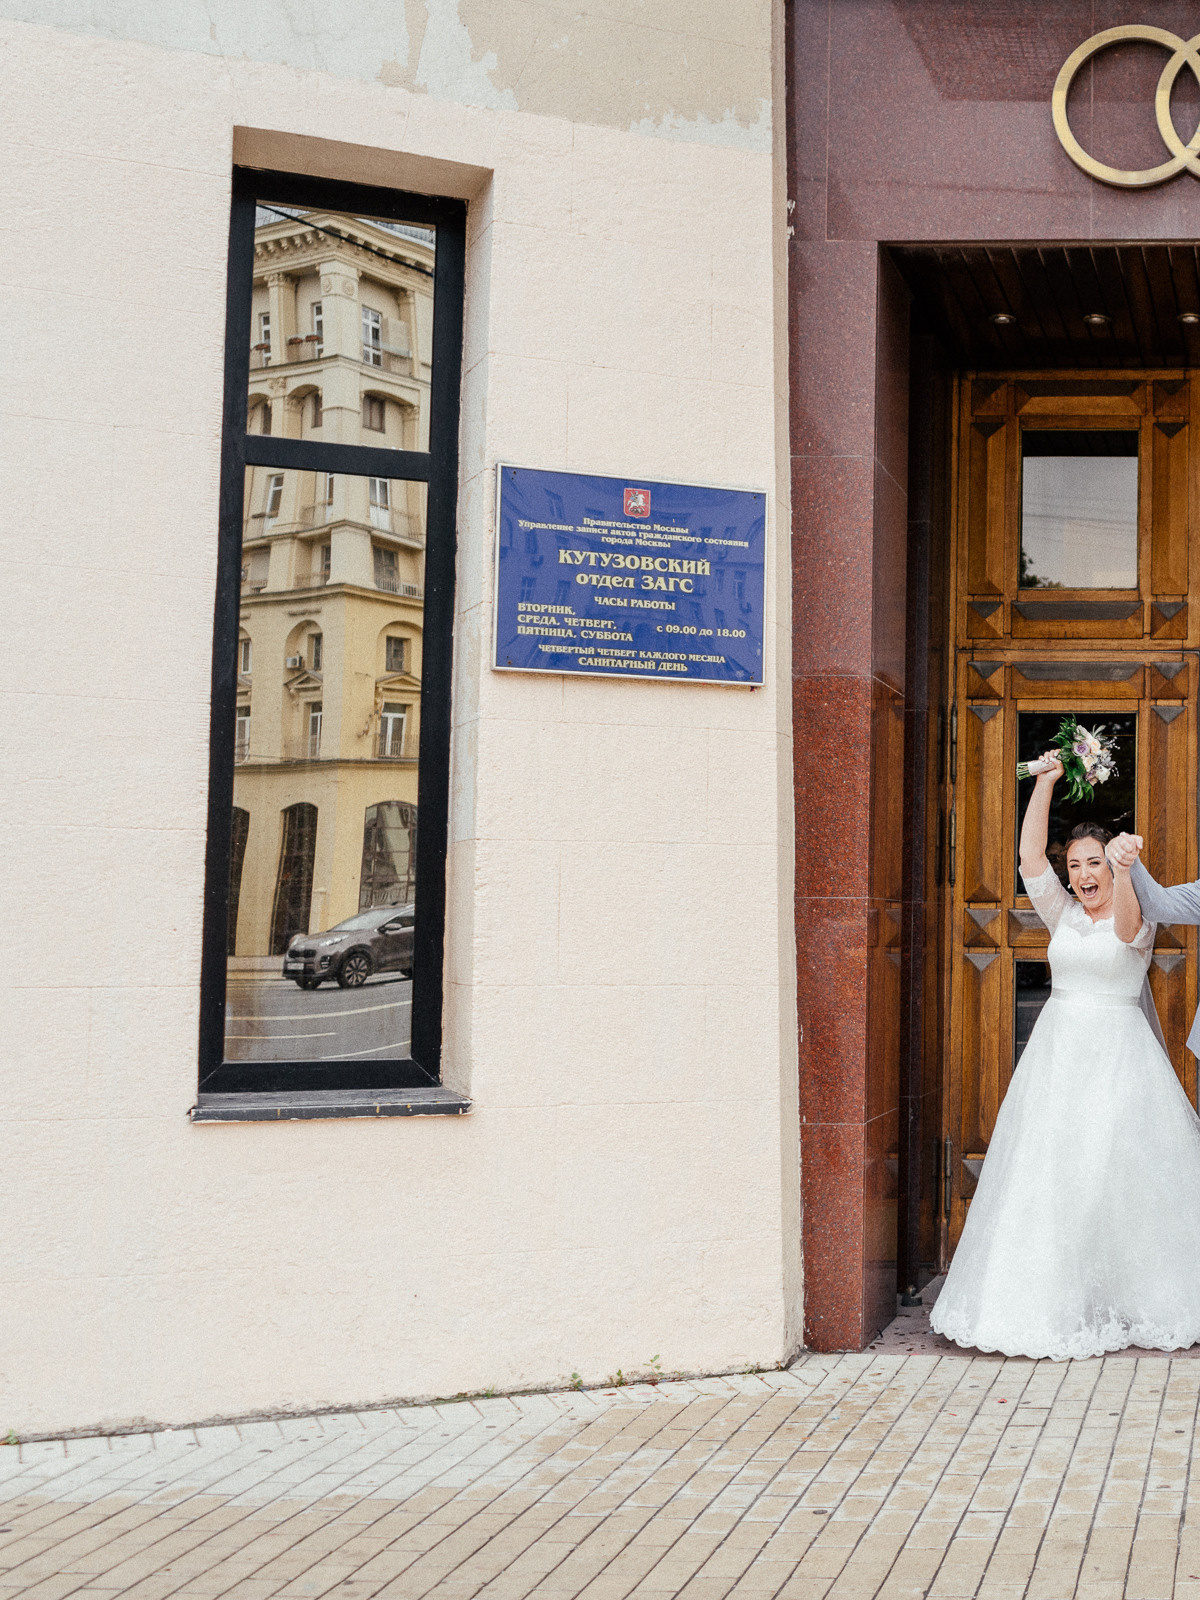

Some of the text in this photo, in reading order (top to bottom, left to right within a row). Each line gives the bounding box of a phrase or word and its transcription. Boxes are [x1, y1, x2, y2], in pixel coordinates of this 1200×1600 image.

[518, 520, 574, 532] Управление
[639, 532, 702, 543] гражданского
[704, 538, 749, 547] состояния
[583, 517, 689, 534] Правительство Москвы
[601, 536, 671, 548] города Москвы
[558, 549, 711, 576] КУТУЗОВСКИЙ
[575, 573, 694, 593] отдел ЗАГС
[517, 602, 576, 615] ВТОРНИК,
[594, 596, 676, 610] ЧАСЫ РАБОТЫ
[564, 617, 617, 629] ЧЕТВЕРГ,
[665, 624, 697, 635] 09.00
[699, 628, 713, 636] до
[716, 628, 746, 638] 18.00
[517, 625, 633, 642] ПЯТНИЦА, СУББОТА
[538, 644, 725, 663] ЧЕТВЕРТЫЙ ЧЕТВЕРГ КАЖДОГО МЕСЯЦА
[578, 657, 688, 672] САНИТАРНЫЙ ДЕНЬ
